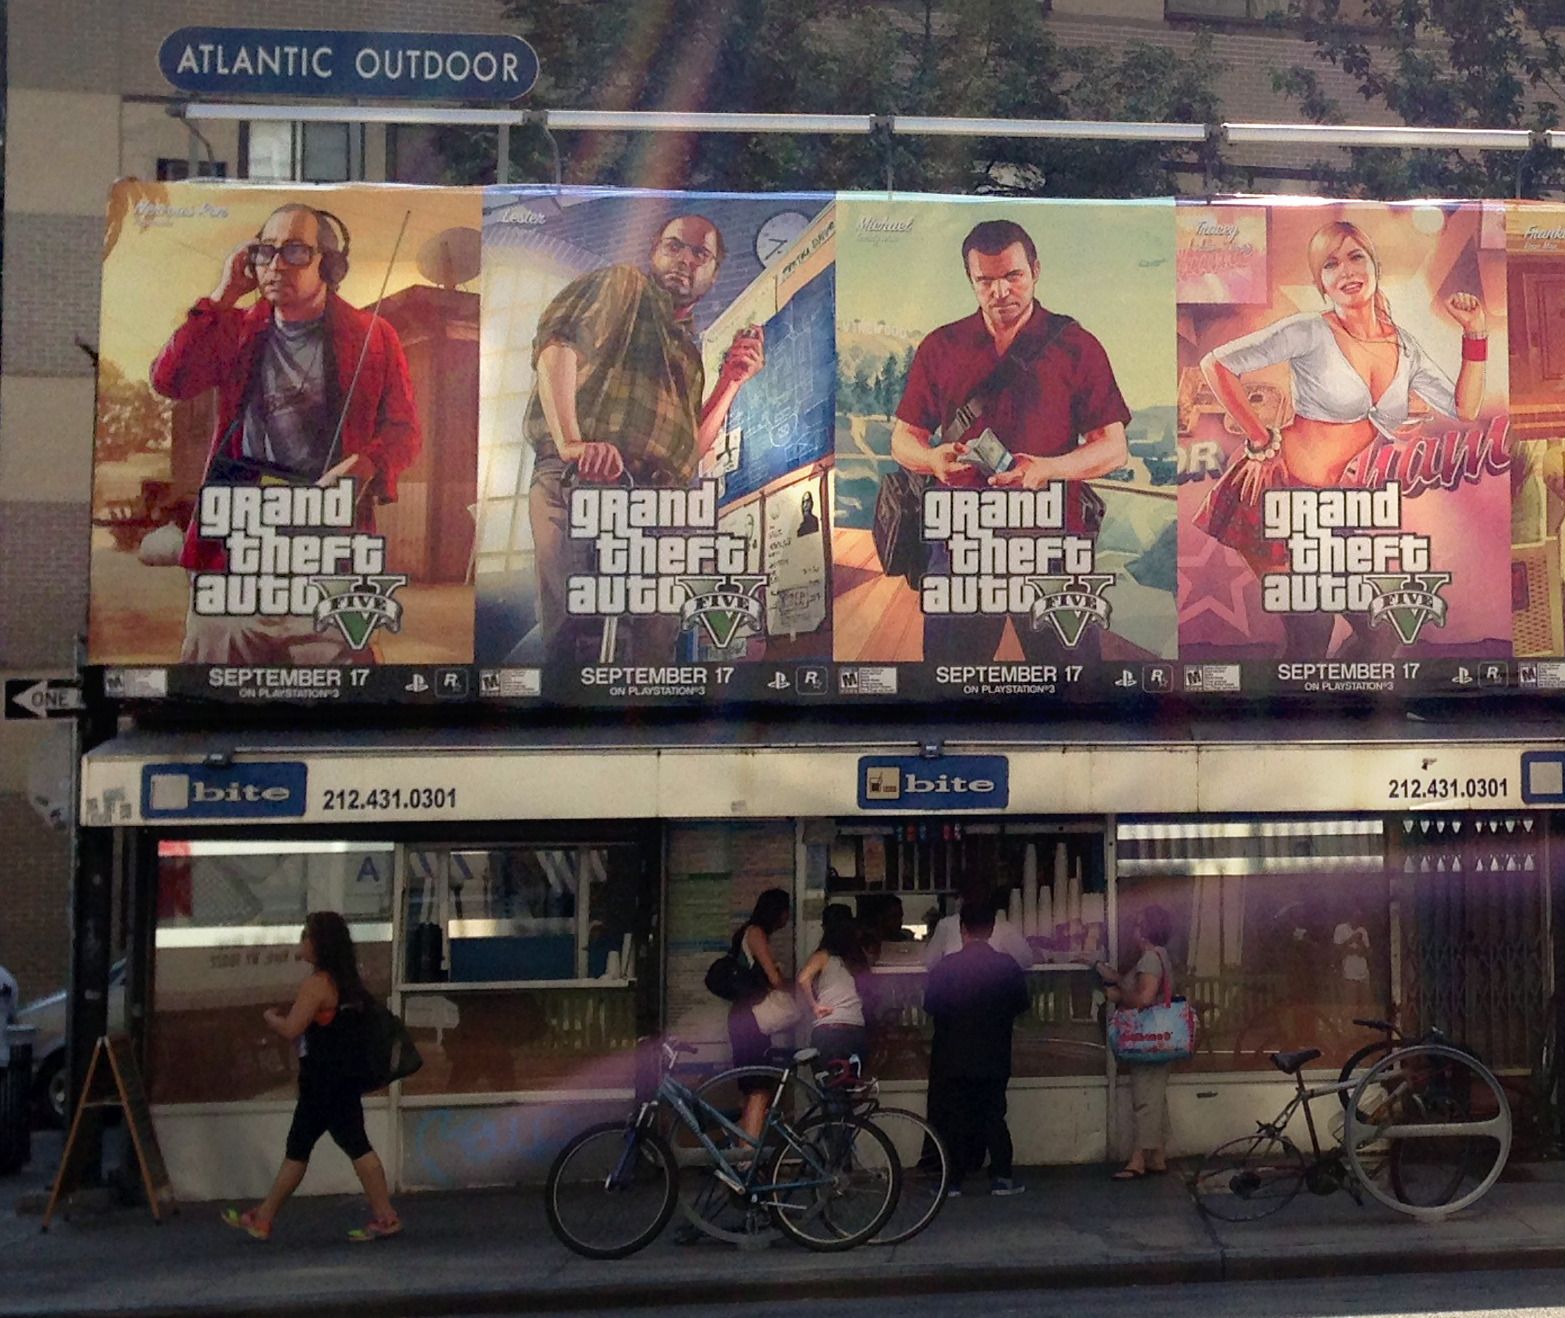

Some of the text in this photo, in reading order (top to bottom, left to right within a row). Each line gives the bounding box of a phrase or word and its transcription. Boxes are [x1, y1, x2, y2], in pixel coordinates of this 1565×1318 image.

[178, 46, 519, 83] ATLANTIC OUTDOOR
[225, 526, 384, 575] theft
[595, 527, 749, 575] theft
[948, 529, 1095, 575] theft
[1288, 527, 1430, 573] theft
[195, 575, 320, 615] auto
[568, 575, 687, 615] auto
[920, 575, 1035, 615] auto
[1262, 573, 1373, 613] auto
[209, 669, 369, 687] SEPTEMBER 17
[581, 667, 734, 685] SEPTEMBER 17
[936, 665, 1084, 683] SEPTEMBER 17
[1278, 663, 1420, 680] SEPTEMBER 17
[239, 689, 256, 698] ON
[610, 687, 626, 696] ON
[963, 685, 979, 694] ON
[1304, 682, 1319, 691] ON
[31, 691, 69, 707] ONE
[192, 782, 290, 802] bite
[905, 774, 995, 792] bite
[1388, 779, 1508, 799] 212.431.0301
[323, 788, 457, 810] 212.431.0301
[356, 856, 380, 882] A
